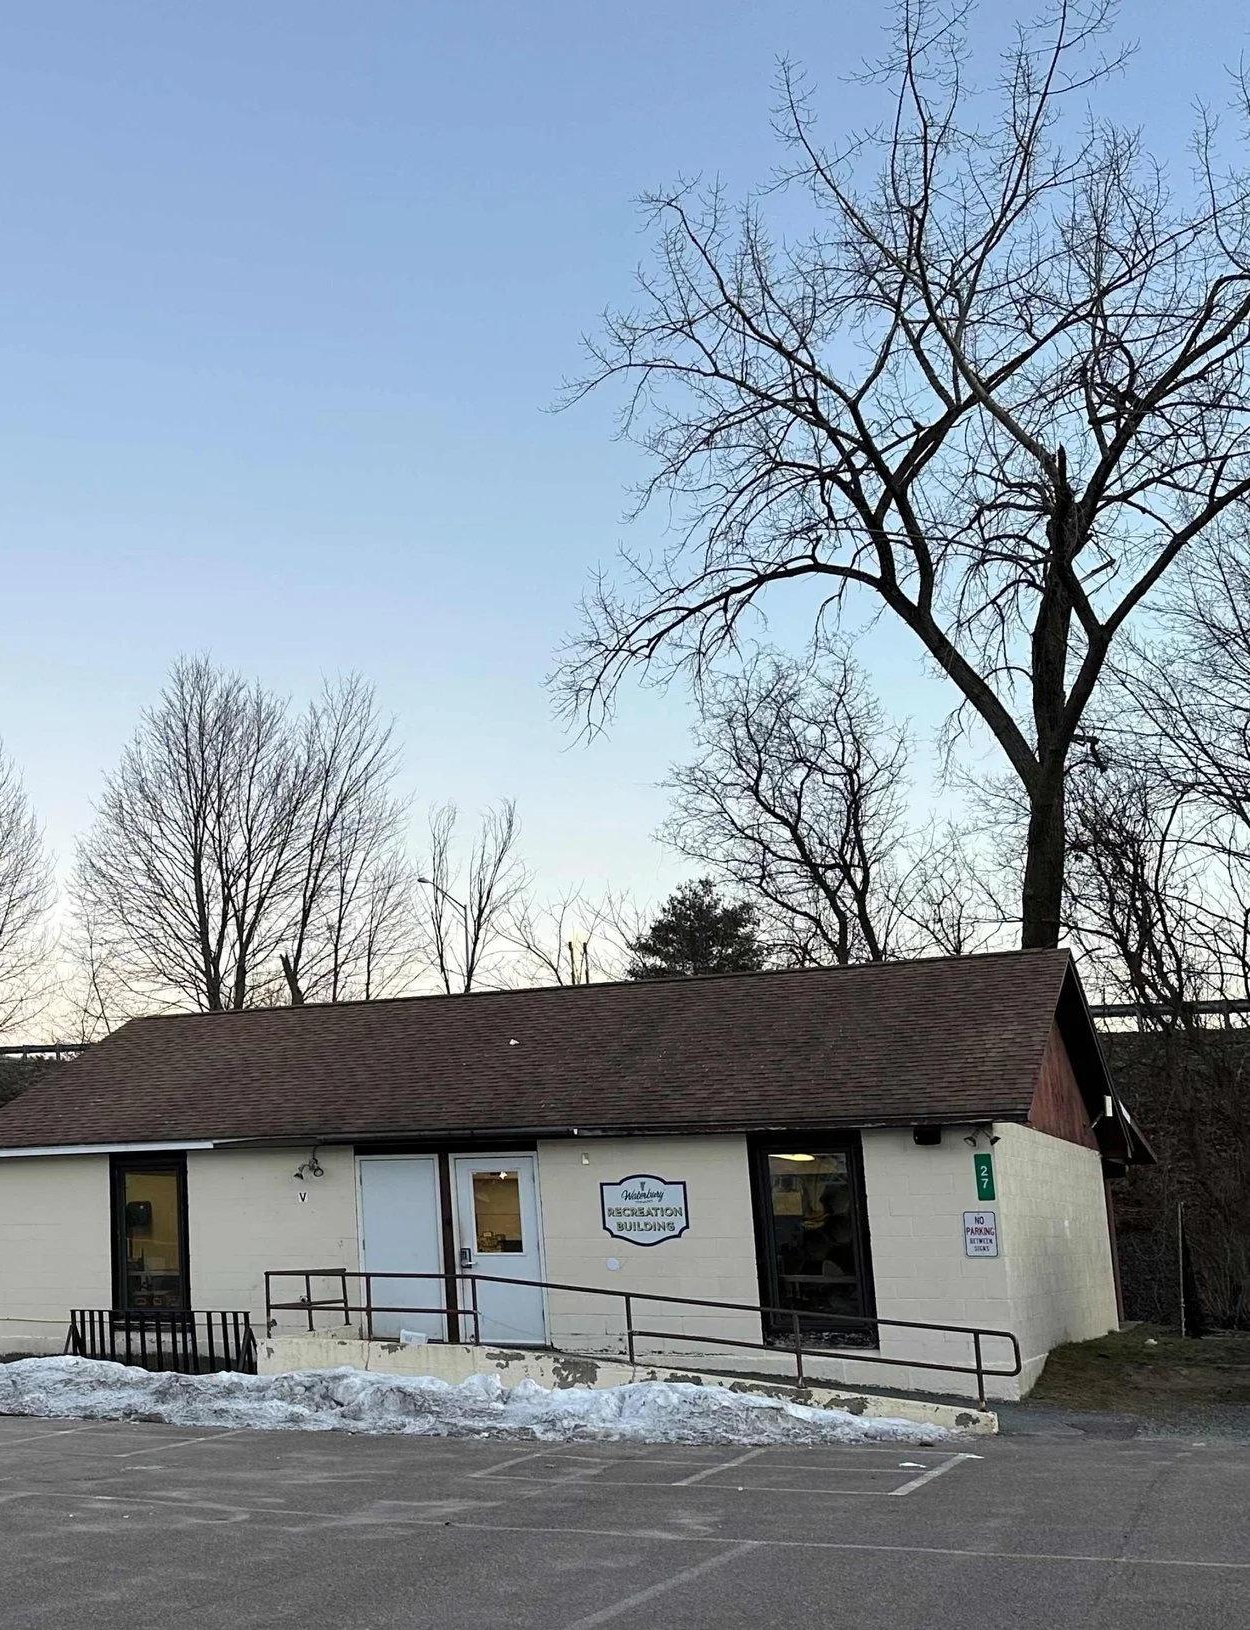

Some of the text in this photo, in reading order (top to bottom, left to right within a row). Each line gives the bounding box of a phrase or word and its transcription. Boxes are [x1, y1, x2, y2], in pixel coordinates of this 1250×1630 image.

[980, 1165, 989, 1189] 27
[621, 1189, 664, 1202] Waterbury
[607, 1207, 683, 1217] RECREATION
[974, 1216, 985, 1225] NO
[616, 1221, 675, 1231] BUILDING
[966, 1227, 995, 1236] PARKING
